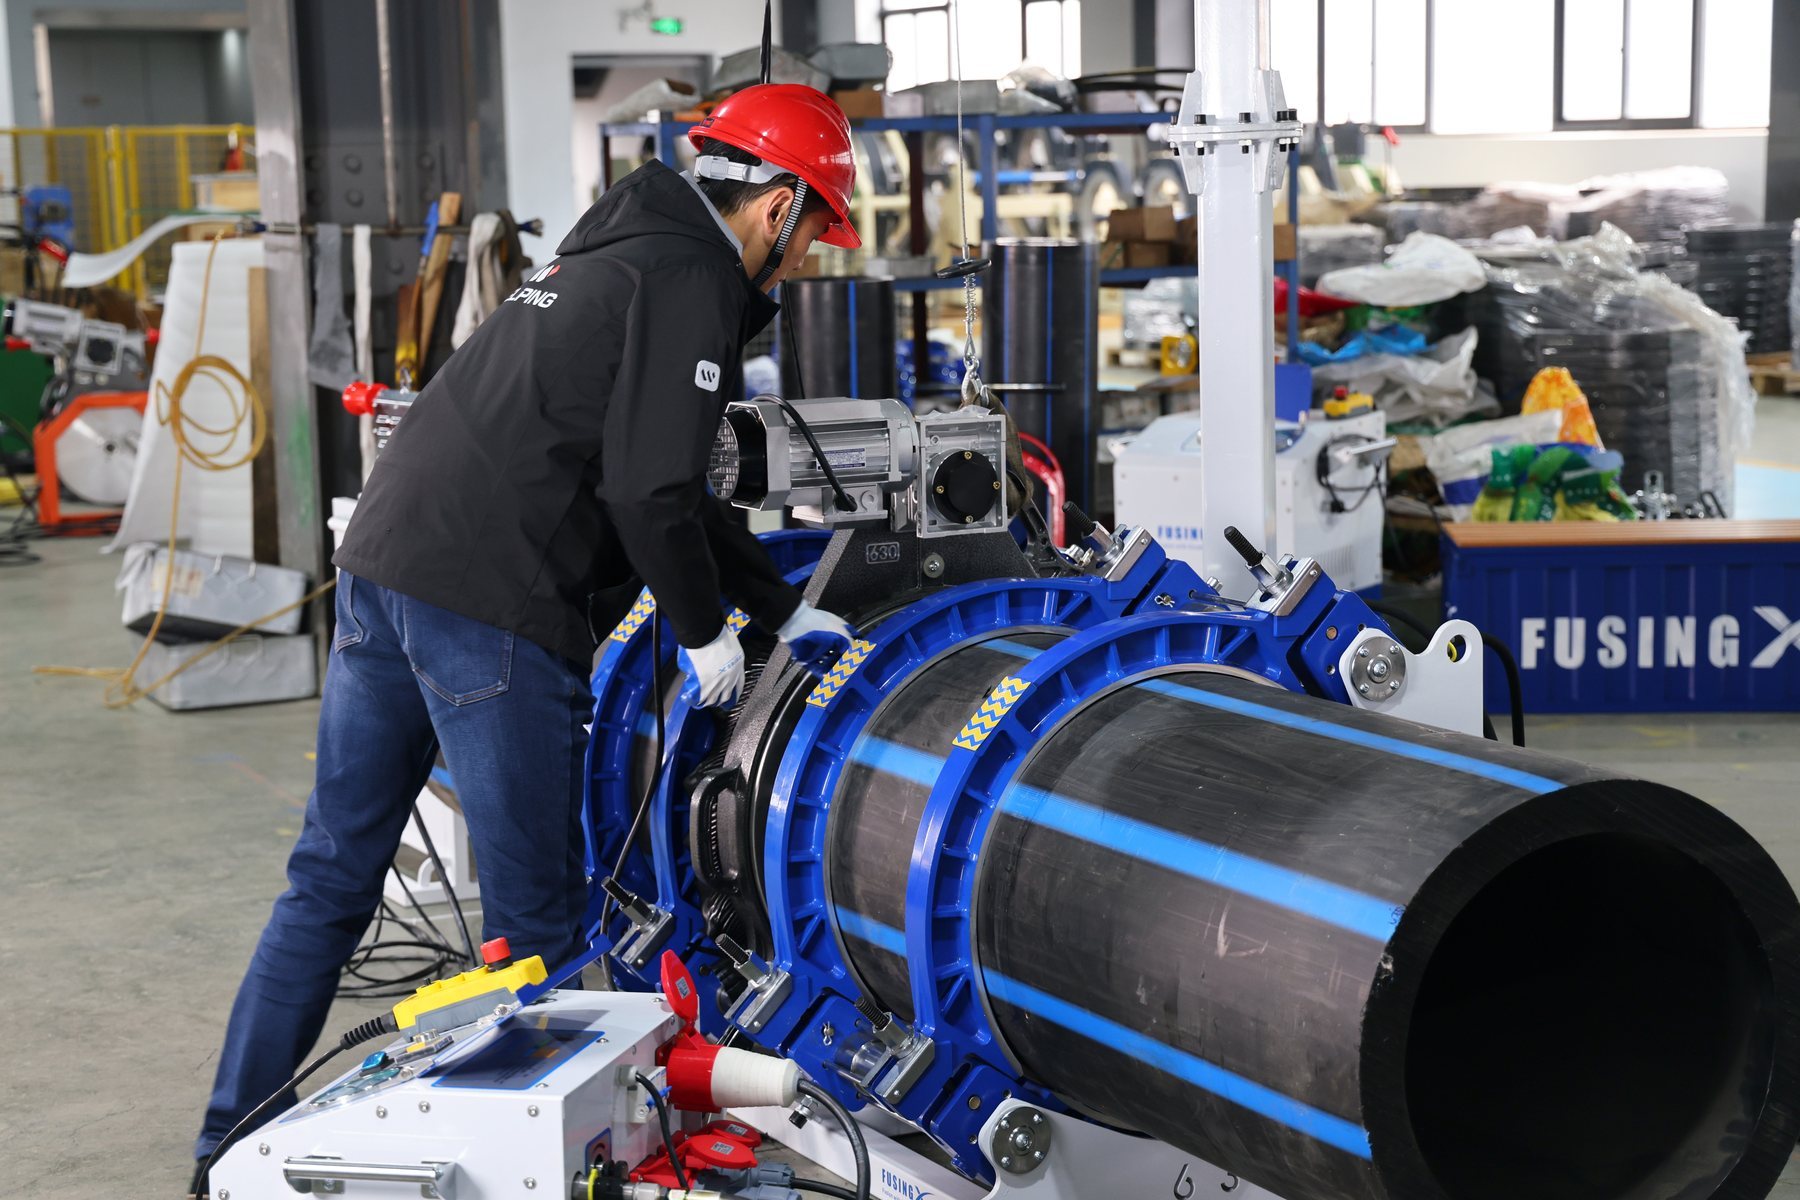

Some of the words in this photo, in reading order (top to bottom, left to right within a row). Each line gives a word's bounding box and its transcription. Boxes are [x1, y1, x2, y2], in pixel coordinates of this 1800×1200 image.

[504, 287, 558, 308] LPING
[1157, 526, 1203, 540] FUSIN
[870, 545, 897, 560] 630
